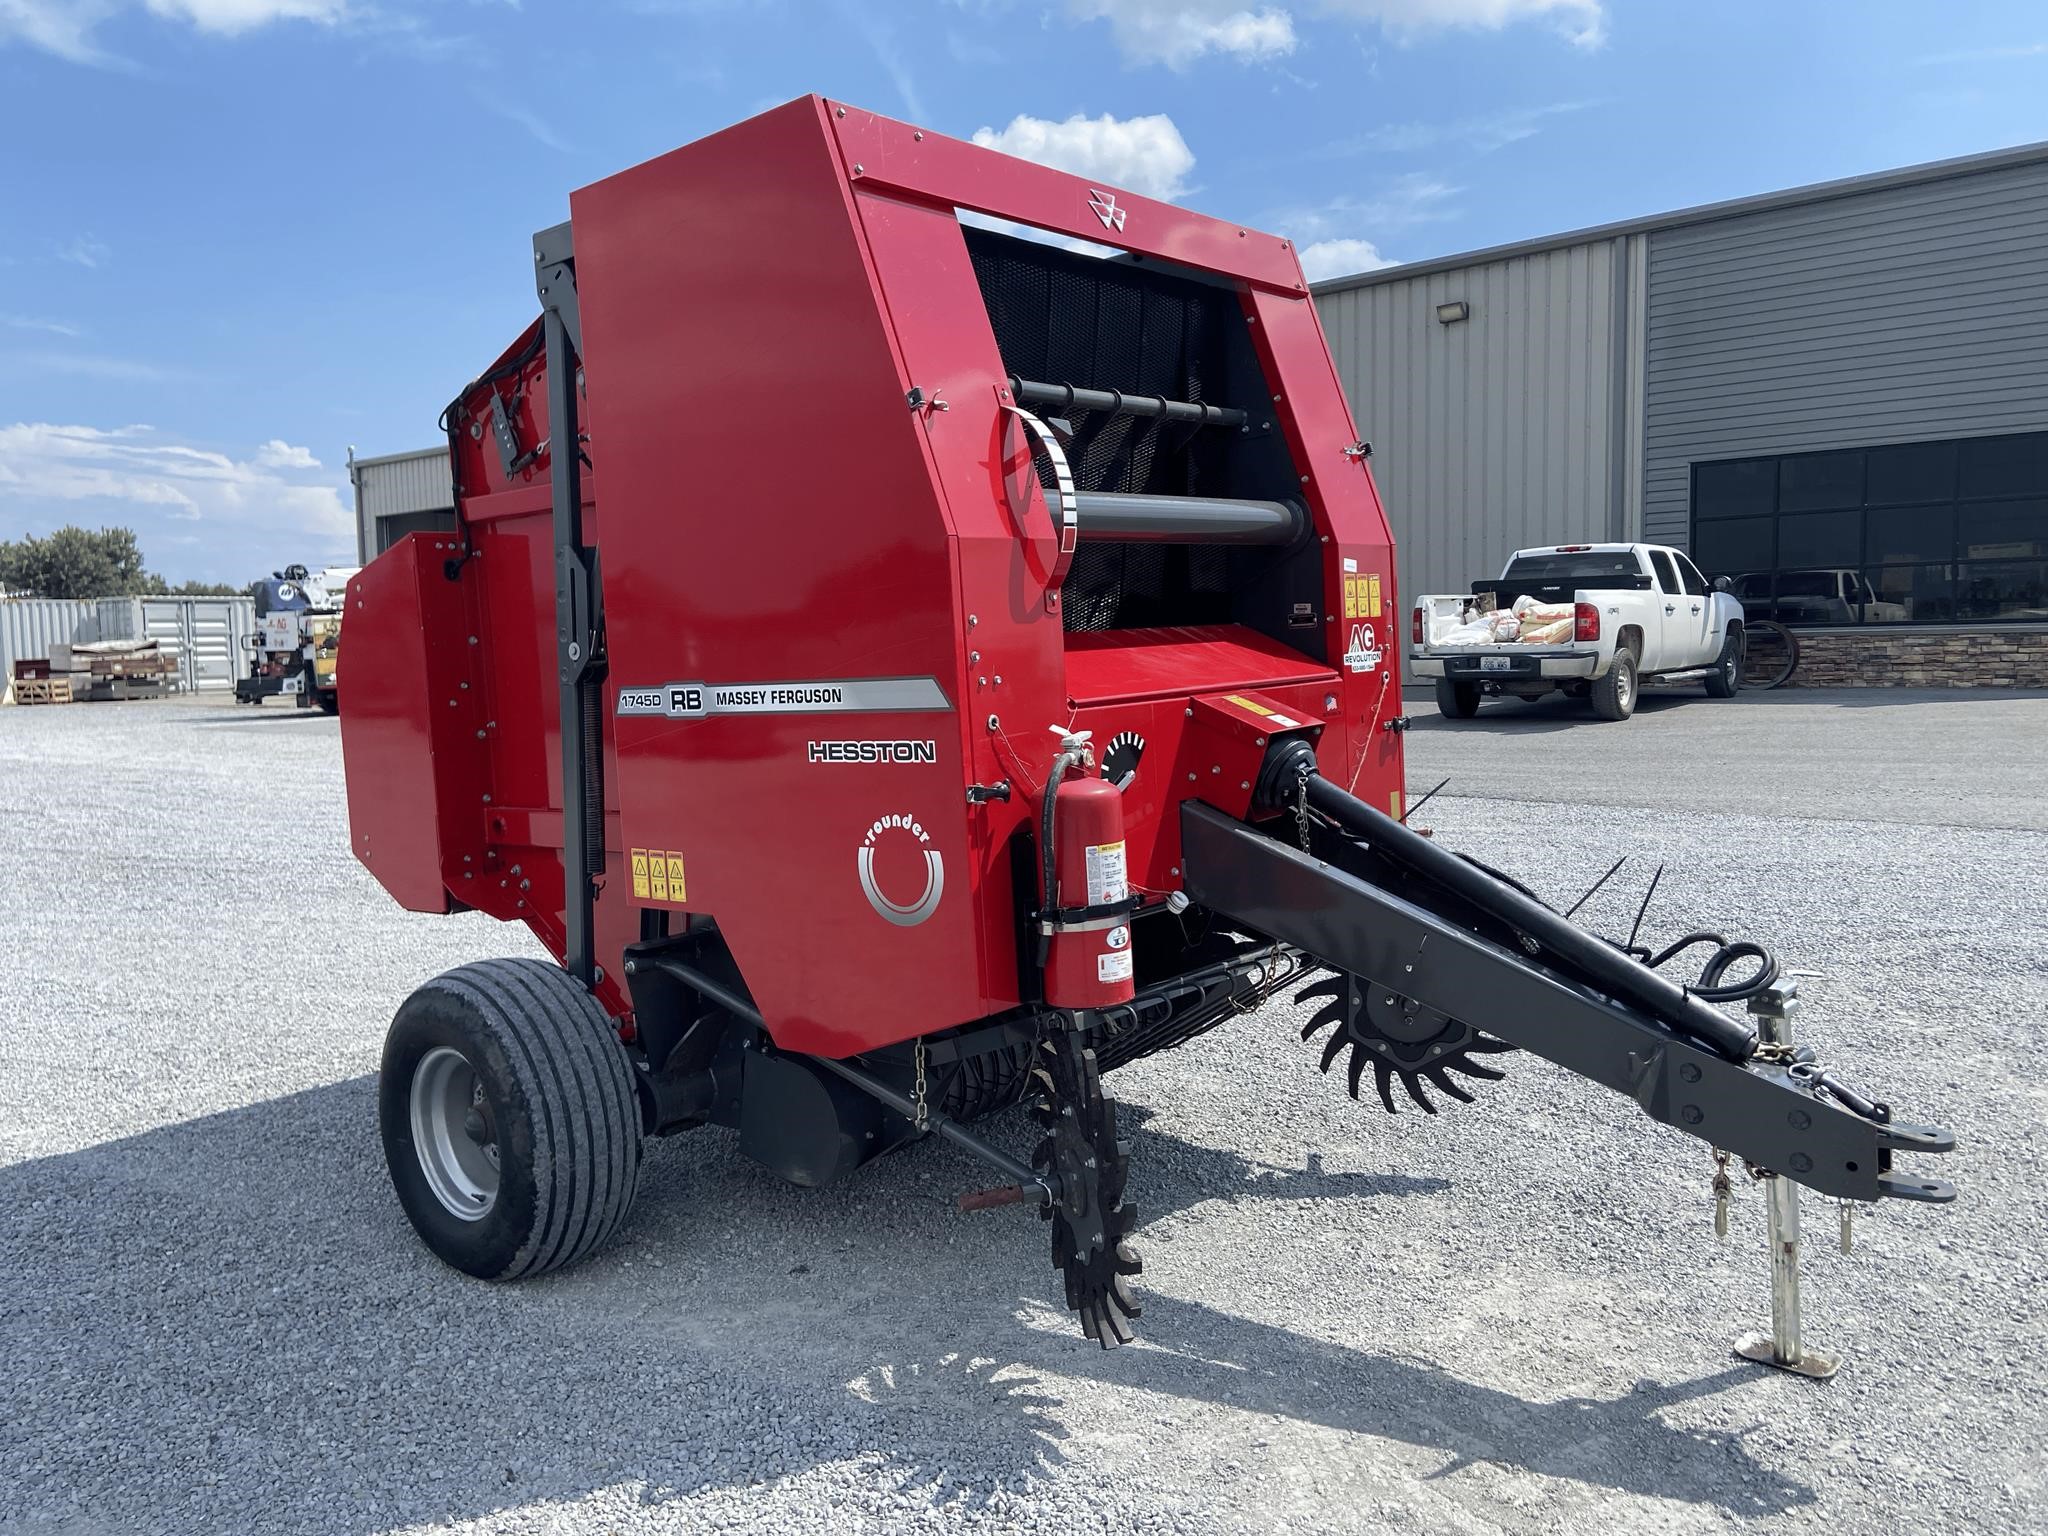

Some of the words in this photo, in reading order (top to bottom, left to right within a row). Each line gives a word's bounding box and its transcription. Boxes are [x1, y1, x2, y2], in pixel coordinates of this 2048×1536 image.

[1350, 624, 1375, 652] AG
[1345, 653, 1381, 664] REVOLUTION
[621, 694, 662, 707] 1745D
[670, 688, 703, 712] RB
[716, 691, 767, 706] MASSEY
[771, 688, 843, 705] FERGUSON
[807, 740, 937, 764] HESSTON
